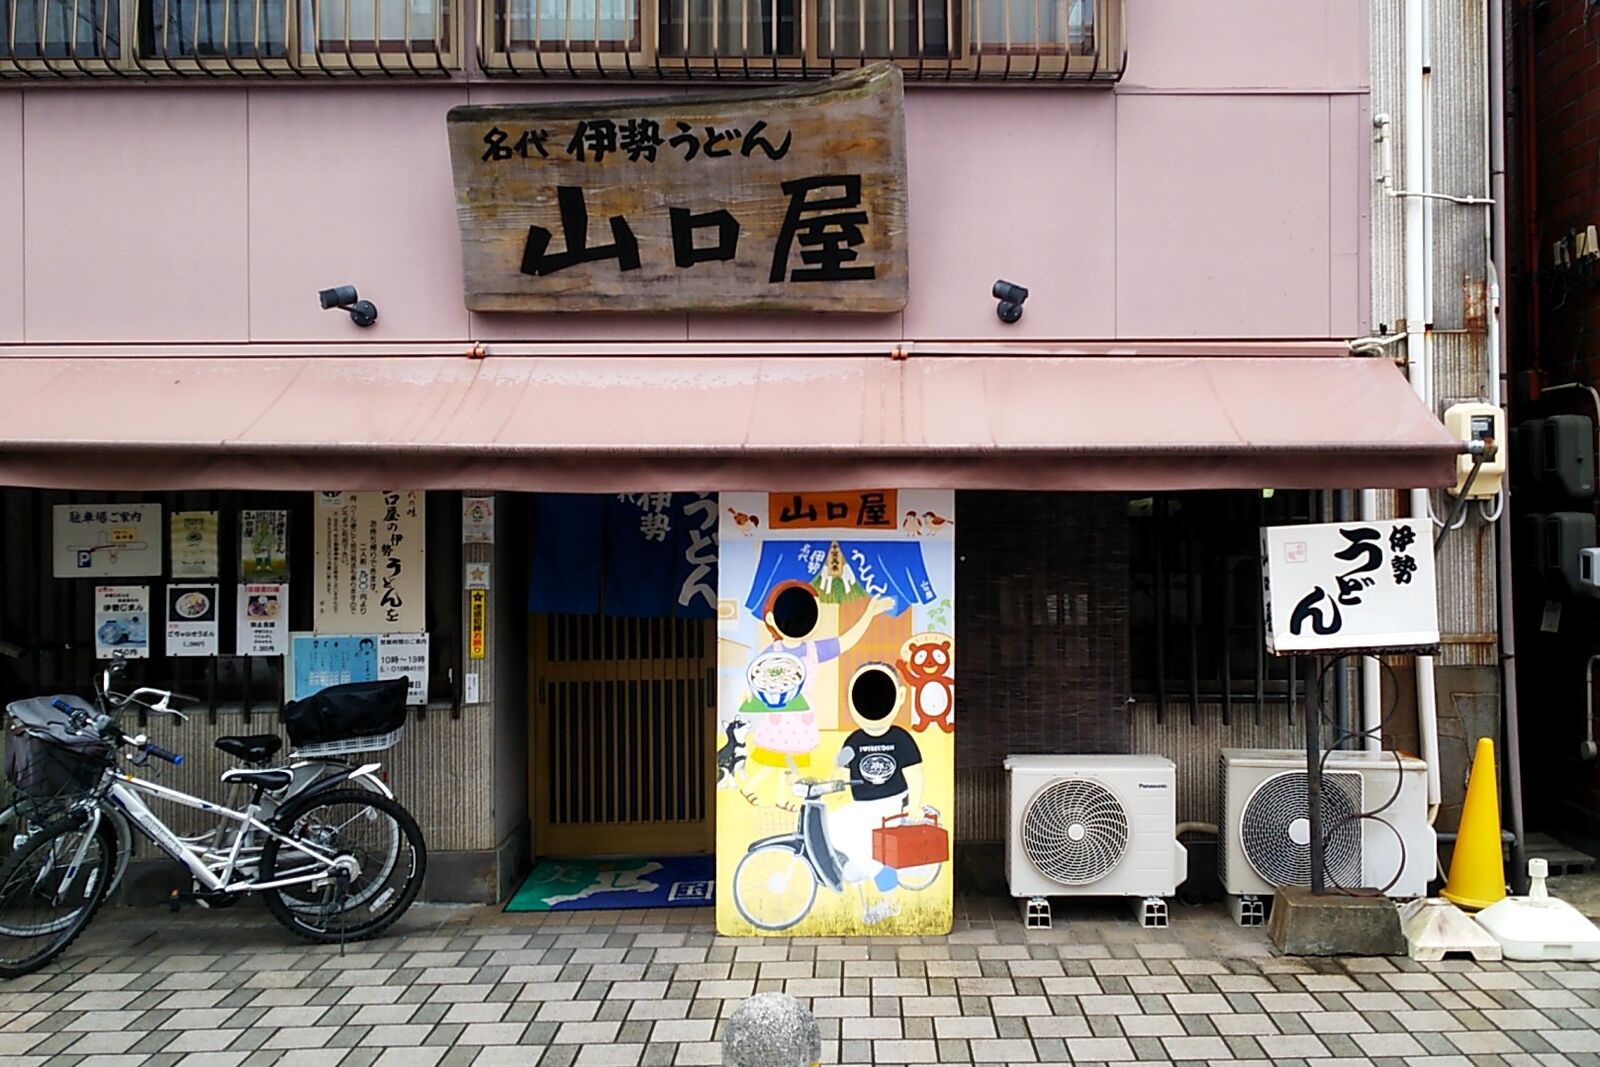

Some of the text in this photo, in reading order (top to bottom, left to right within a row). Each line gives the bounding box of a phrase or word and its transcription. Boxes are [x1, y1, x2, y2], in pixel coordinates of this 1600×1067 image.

[481, 119, 793, 163] 名代 伊勢うどん
[520, 174, 876, 284] 山口屋
[69, 510, 142, 524] 駐車場ご案内
[636, 492, 672, 542] 伊勢
[779, 493, 890, 526] 山口屋
[79, 552, 91, 566] P
[381, 491, 403, 622] 口屋の伊勢うどんを
[678, 491, 719, 610] うどん
[1389, 525, 1417, 585] 伊勢
[1290, 527, 1383, 635] うどん
